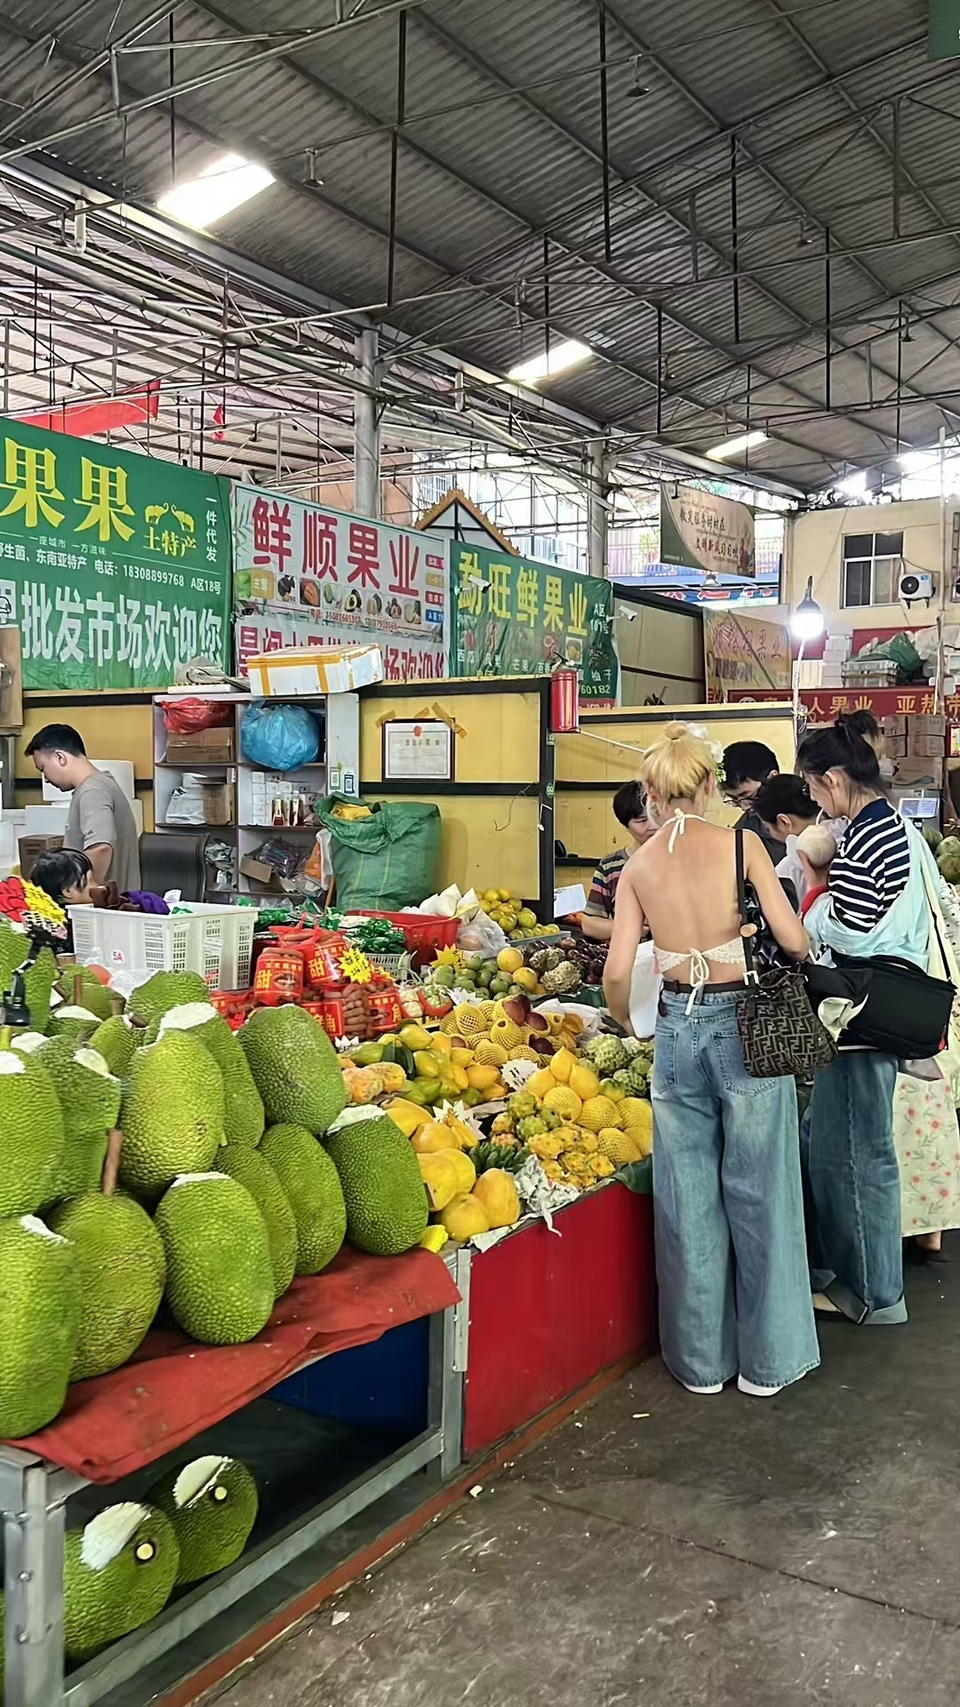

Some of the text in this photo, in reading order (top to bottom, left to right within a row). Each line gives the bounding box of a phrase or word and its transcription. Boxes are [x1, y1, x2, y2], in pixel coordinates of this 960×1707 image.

[29, 535, 67, 549] 一座城市
[143, 526, 198, 558] 土特产
[205, 496, 218, 563] 一件代发
[252, 496, 419, 597] 鲜顺果业
[190, 578, 222, 596] A区18号
[21, 579, 223, 672] 批发市场欢迎您
[457, 648, 475, 664] 西瓜
[512, 658, 530, 672] 芒果
[591, 668, 612, 682] 柚子
[256, 970, 273, 989] 甜
